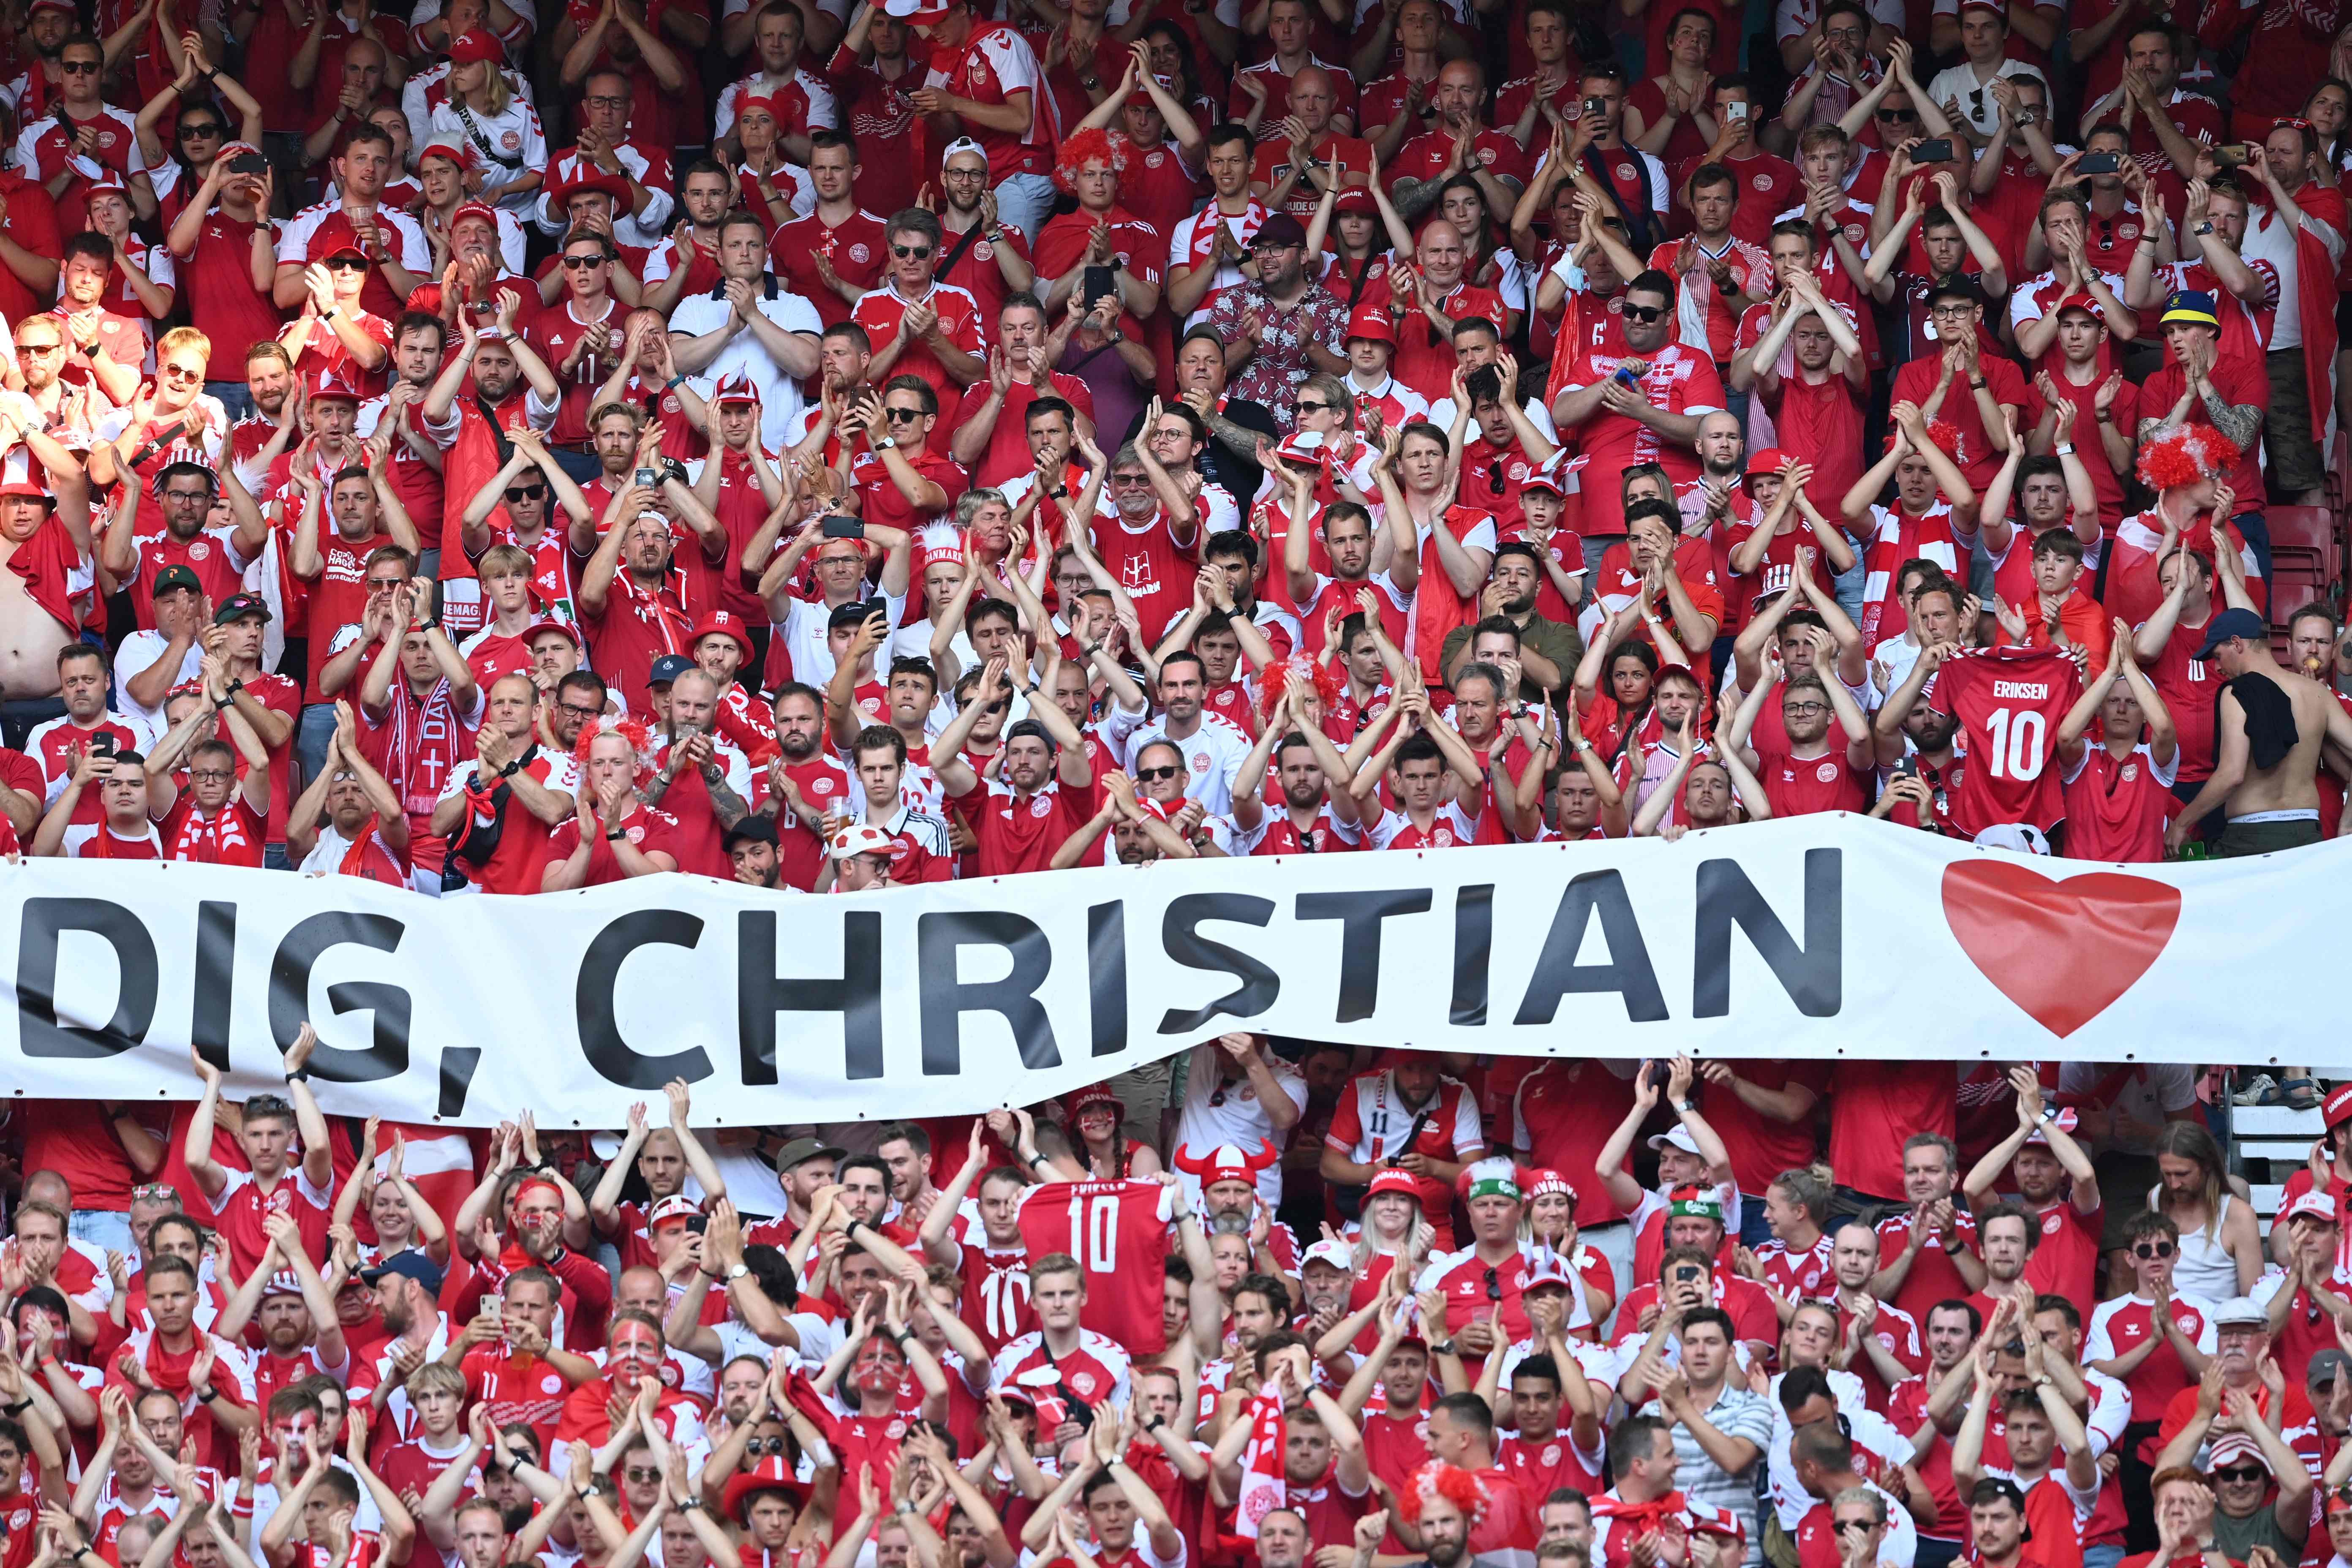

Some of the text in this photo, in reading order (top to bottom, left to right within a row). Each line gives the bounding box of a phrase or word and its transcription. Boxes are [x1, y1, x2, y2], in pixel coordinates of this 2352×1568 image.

[1284, 201, 1308, 211] RUDE
[1337, 191, 1362, 203] ANMARK
[1822, 247, 1834, 275] 4
[868, 322, 889, 330] hummel
[1364, 316, 1388, 326] DANMARK
[578, 354, 595, 384] 11
[925, 552, 962, 564] DANMARK
[1123, 581, 1160, 598] NMARK
[2189, 659, 2205, 681] 10
[1993, 680, 2048, 700] ERIKSEN
[1986, 708, 2046, 781] 10
[1936, 800, 1949, 815] 4
[17, 848, 1842, 1118] DIG, CHRISTIAN
[1370, 1112, 1388, 1133] 11
[1068, 1195, 1120, 1274] 10
[981, 1272, 1032, 1339] 10
[483, 1371, 498, 1399] 11
